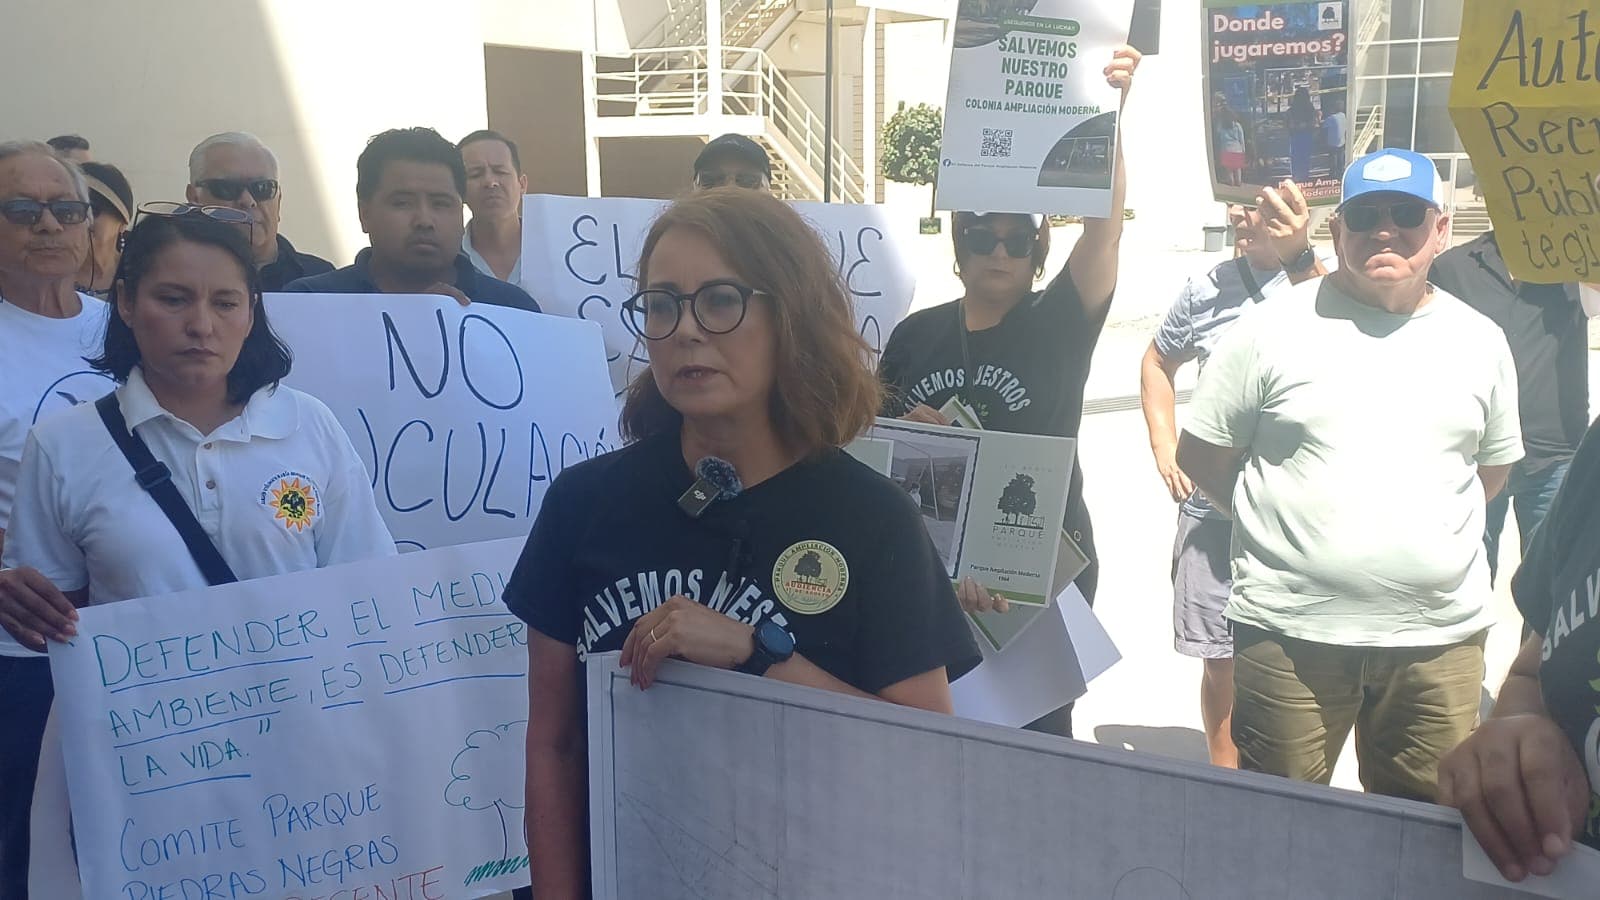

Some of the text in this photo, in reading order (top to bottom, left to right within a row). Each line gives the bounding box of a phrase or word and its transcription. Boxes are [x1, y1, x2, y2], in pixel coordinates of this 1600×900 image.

[1214, 11, 1284, 32] Donde
[998, 36, 1077, 59] SALVEMOS
[1212, 33, 1345, 63] jugaremos?
[1001, 57, 1068, 79] NUESTRO
[1005, 79, 1063, 99] PARQUE
[965, 98, 1100, 115] COLONIA AMPLIACIÓN MODERNA
[1278, 181, 1313, 190] Pque
[382, 308, 524, 410] NO
[903, 368, 966, 416] ALVEMOS
[993, 526, 1046, 539] PARQUE
[785, 581, 833, 594] AUDIENCIA
[93, 571, 508, 688] DEFENDER EL MEDI
[576, 568, 704, 663] SALVEMOS
[321, 661, 364, 700] ES
[379, 621, 529, 686] DEFENDER
[121, 753, 167, 787] LA
[262, 783, 382, 838] PARQUE
[278, 834, 399, 888] NEGRAS
